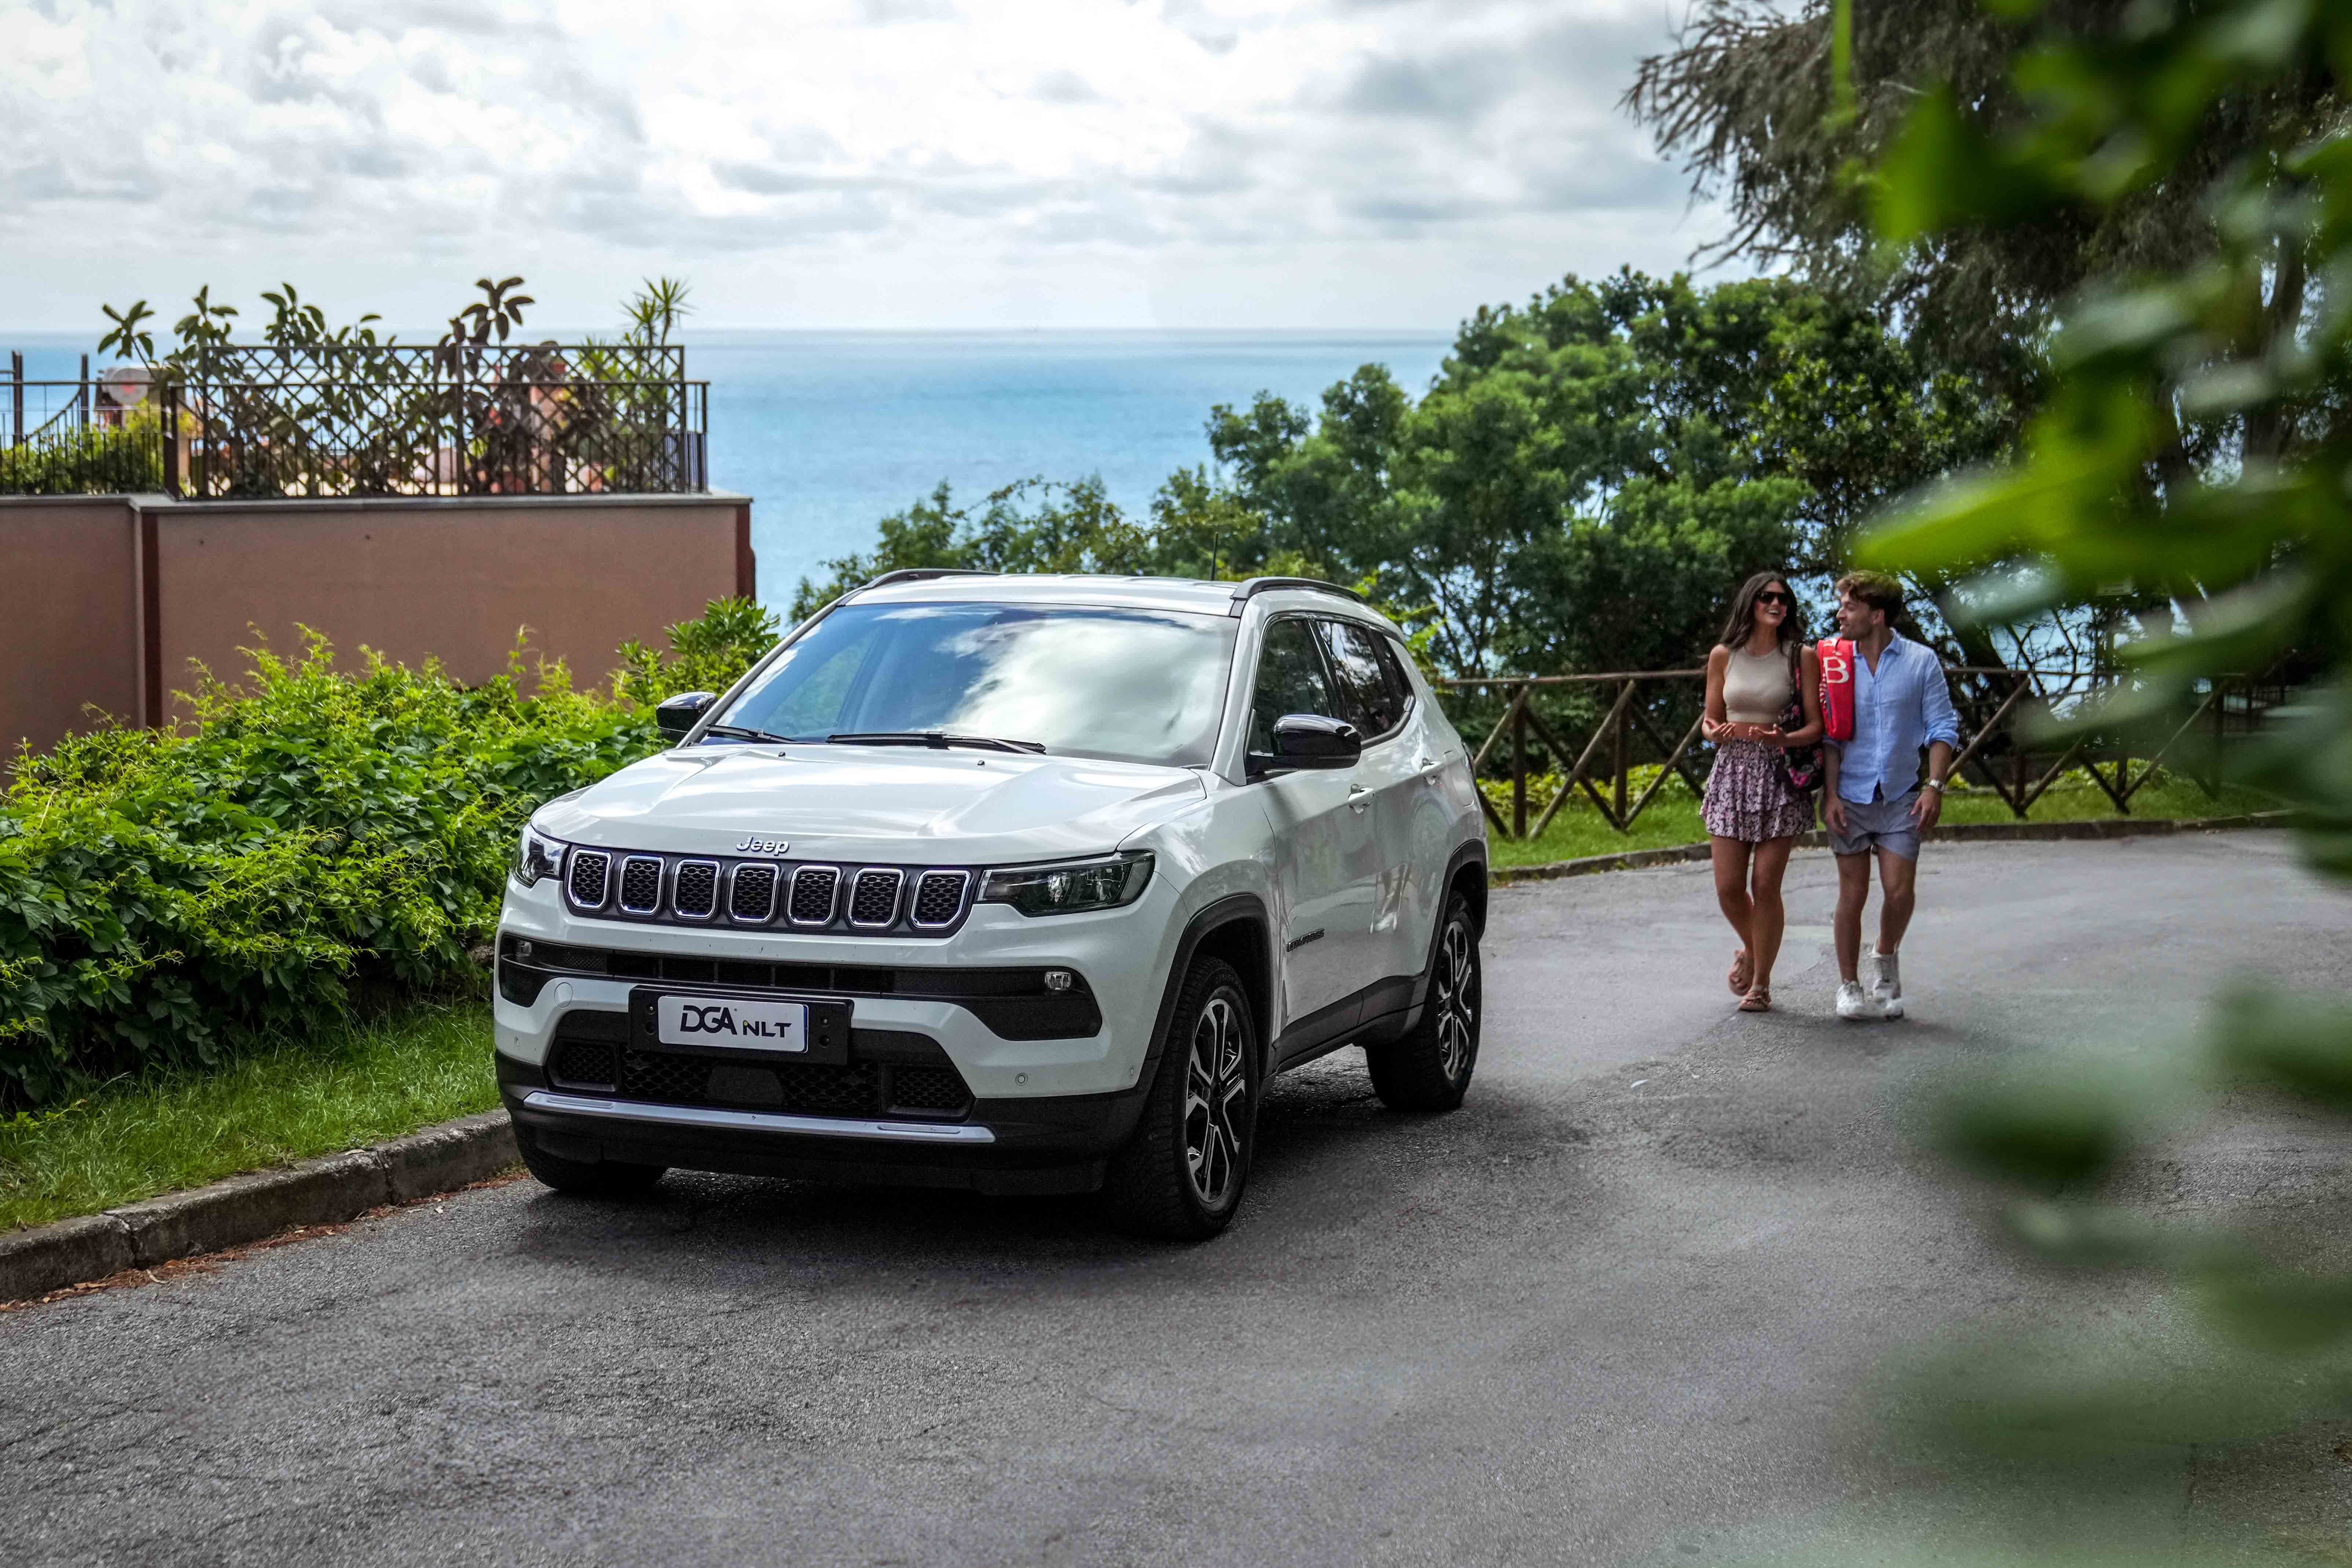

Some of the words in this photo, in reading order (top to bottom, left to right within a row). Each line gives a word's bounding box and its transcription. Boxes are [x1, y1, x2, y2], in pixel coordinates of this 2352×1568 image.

[1823, 656, 1849, 684] B
[736, 836, 789, 856] Jeep
[680, 1005, 738, 1035] DGA
[743, 1020, 792, 1037] NLT
